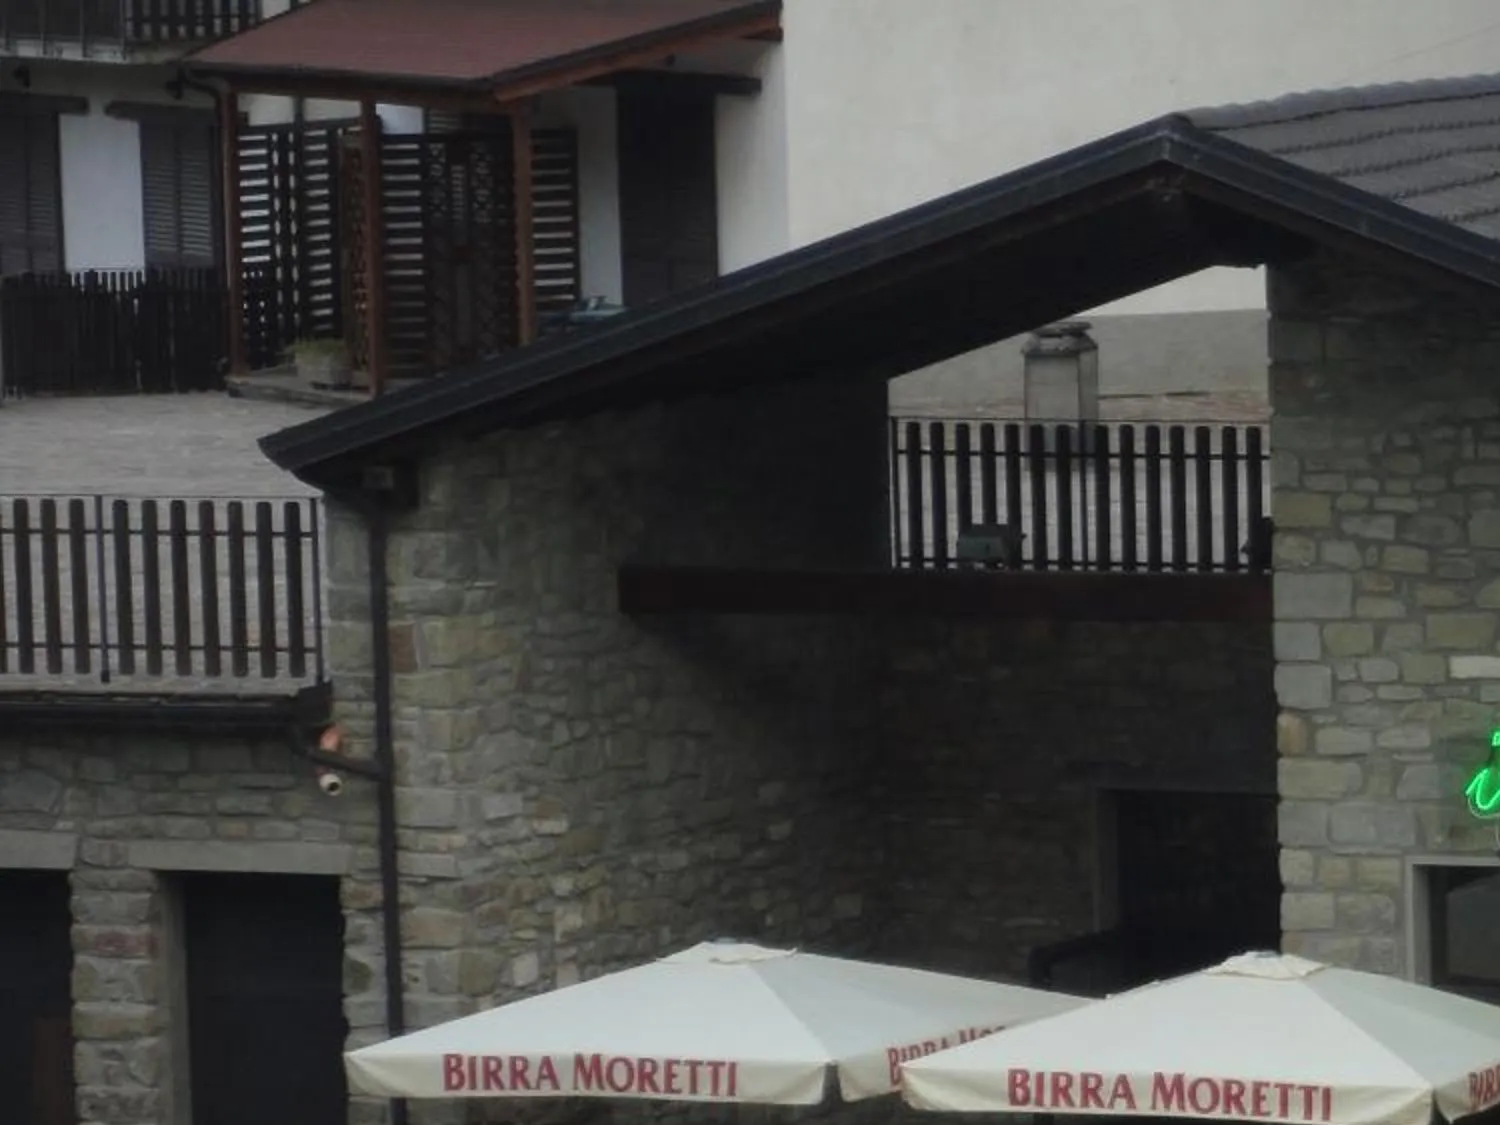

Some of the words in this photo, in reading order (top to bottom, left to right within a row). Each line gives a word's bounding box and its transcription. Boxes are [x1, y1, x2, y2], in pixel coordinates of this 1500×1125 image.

[442, 1053, 560, 1092] BIRRA
[573, 1054, 738, 1096] MORETTI
[1007, 1068, 1138, 1110] BIRRA
[1151, 1071, 1332, 1121] MORETTI
